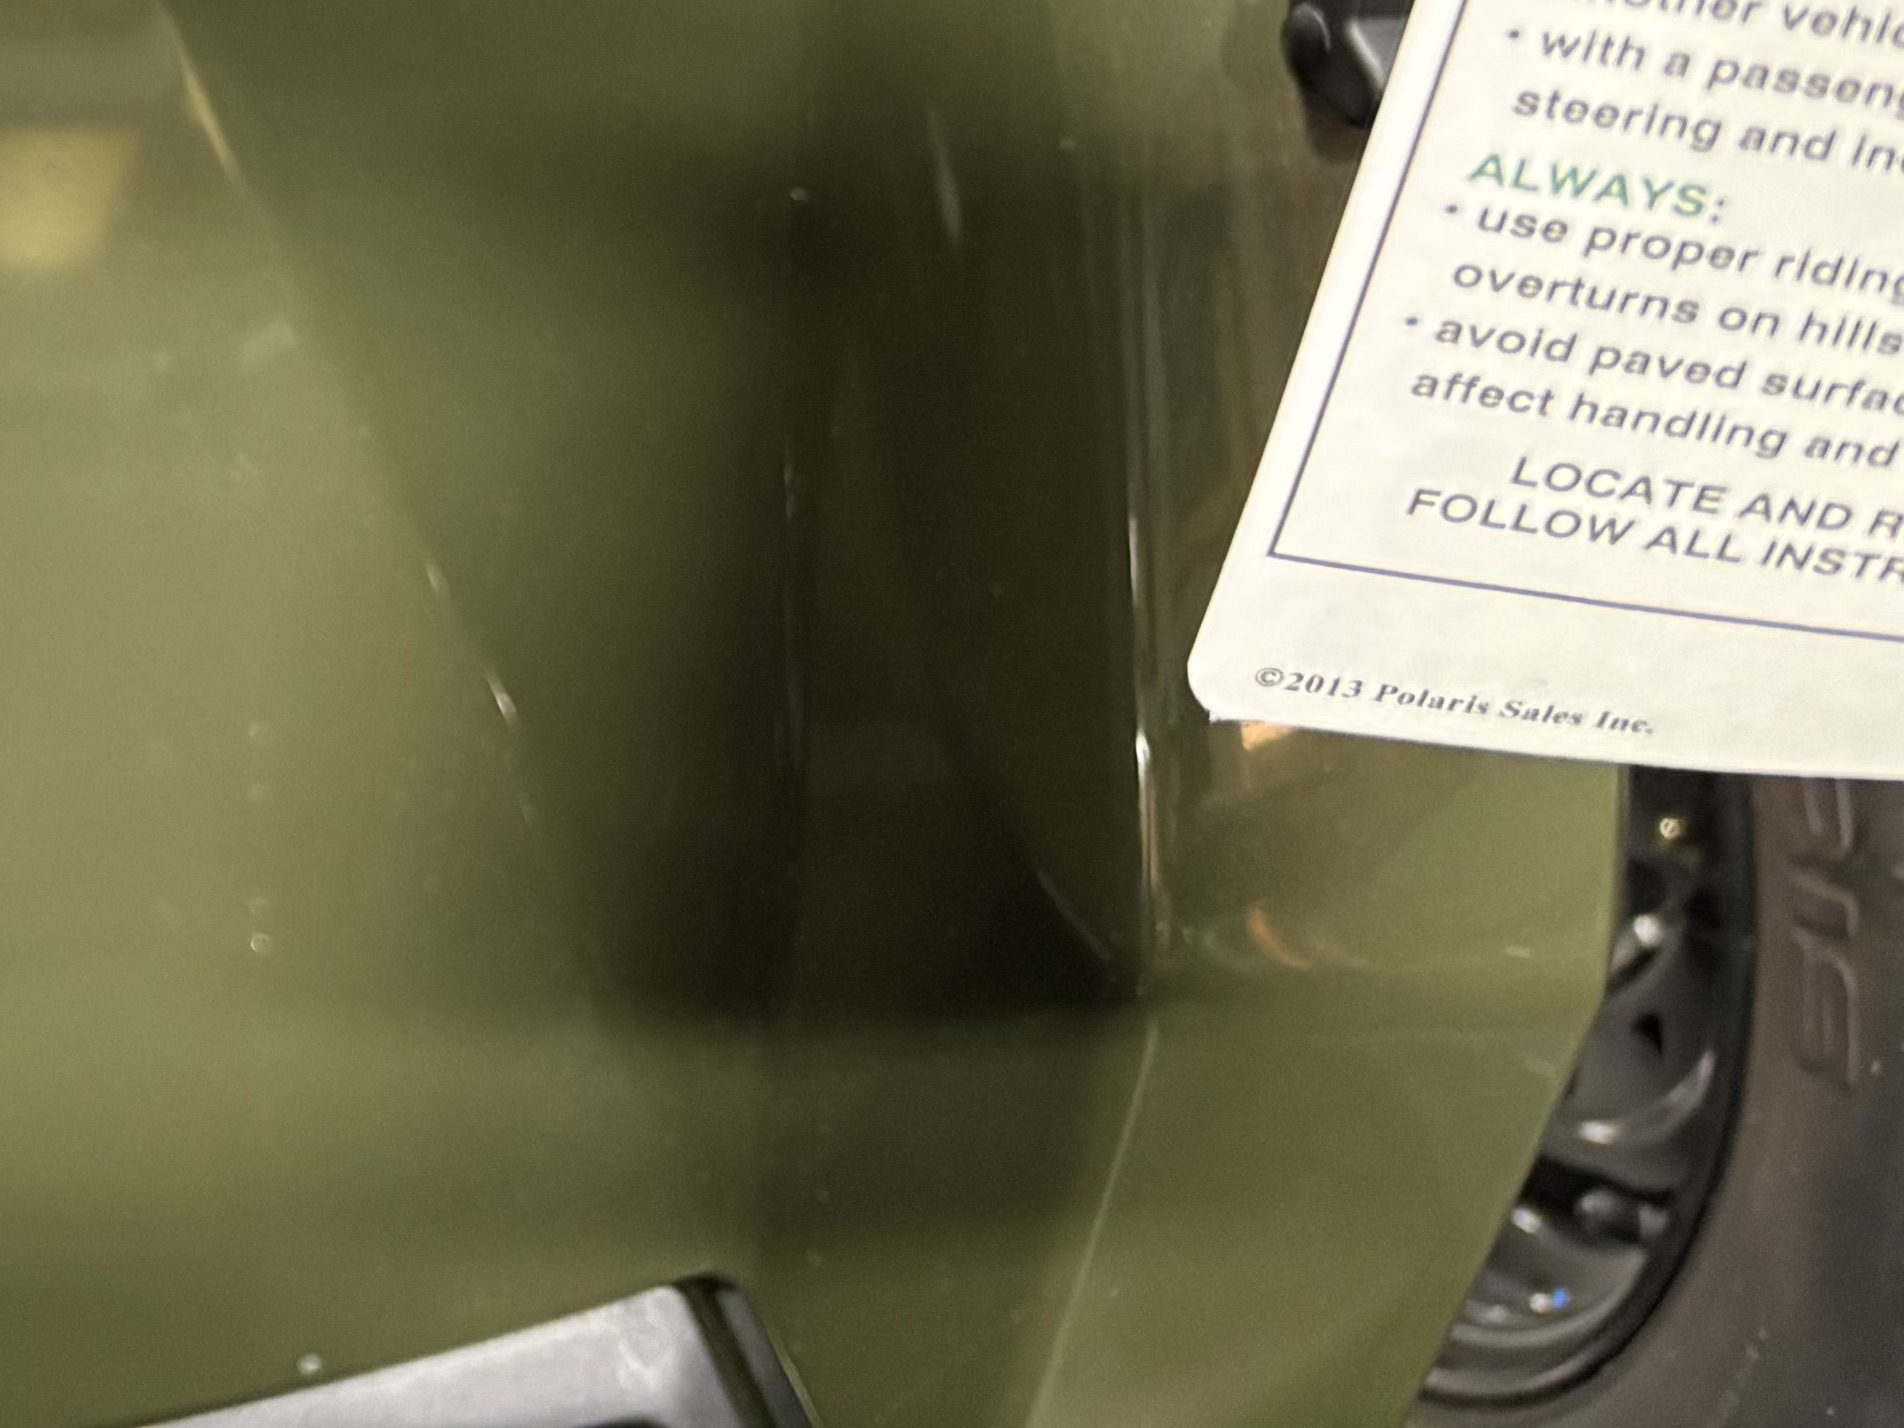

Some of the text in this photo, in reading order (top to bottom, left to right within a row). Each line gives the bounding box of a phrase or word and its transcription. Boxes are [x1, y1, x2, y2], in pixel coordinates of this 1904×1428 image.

[1541, 30, 1645, 69] with
[1664, 52, 1691, 78] a
[1513, 89, 1904, 171] steering and in
[1469, 153, 1725, 223] ALWAYS:
[1478, 206, 1567, 243] use
[1583, 225, 1758, 272] proper
[1453, 263, 1904, 354] overturns on hills
[1435, 319, 1577, 362] avoid
[1589, 344, 1747, 389] paved
[1411, 372, 1900, 468] affect handling and
[1406, 488, 1635, 546] FOLLOW
[1645, 527, 1742, 563] ALL
[1510, 456, 1728, 515] LOCATE
[1738, 493, 1852, 531] AND
[1255, 667, 1653, 735] ©2013 Polaris Sales Inc.
